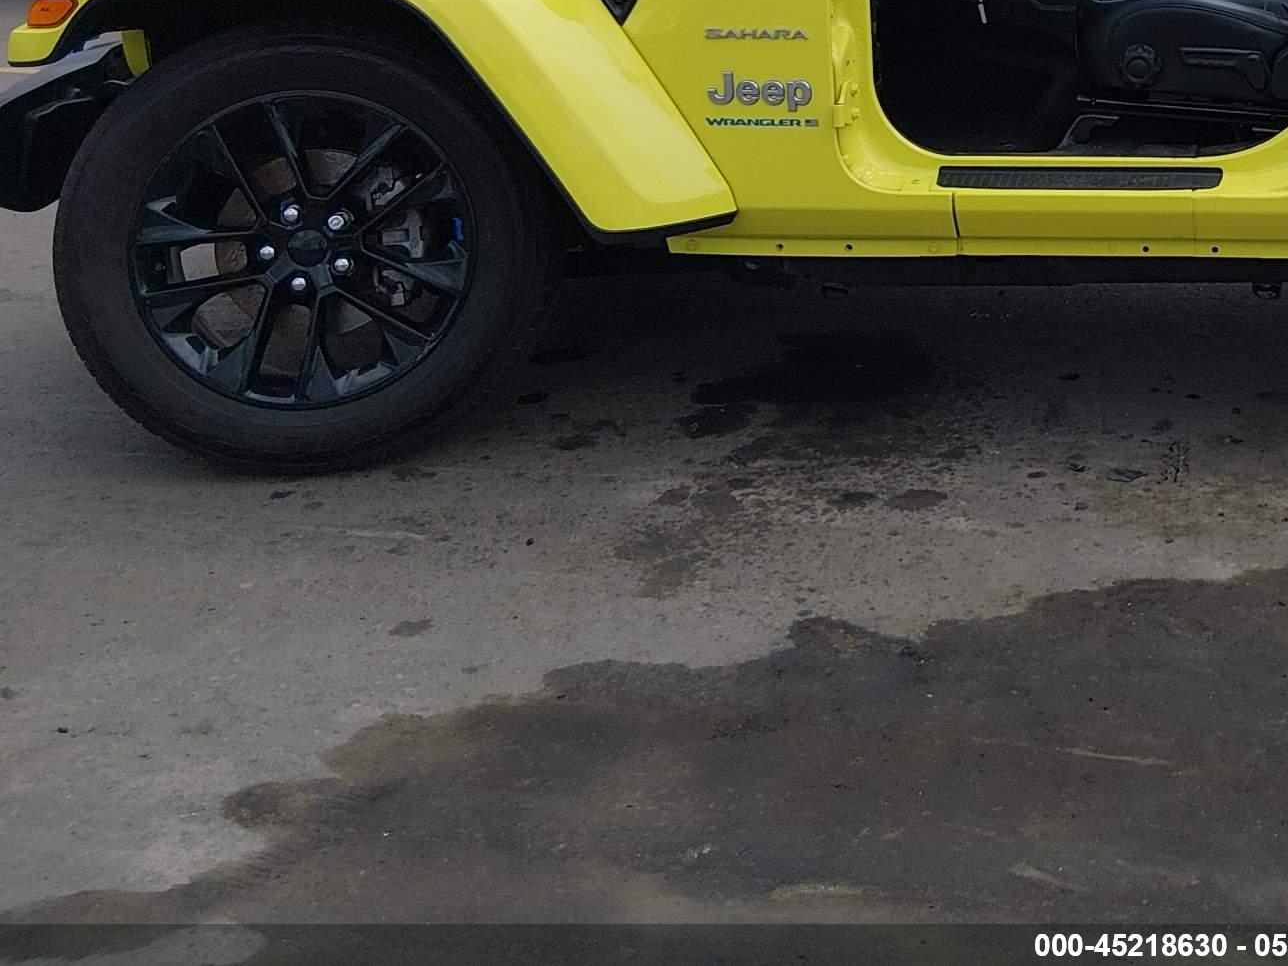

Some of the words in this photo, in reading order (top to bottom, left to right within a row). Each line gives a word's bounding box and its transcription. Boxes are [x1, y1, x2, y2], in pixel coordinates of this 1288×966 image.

[704, 27, 809, 40] SAHARA
[706, 70, 813, 112] Jeep
[705, 117, 802, 127] WRANGLER
